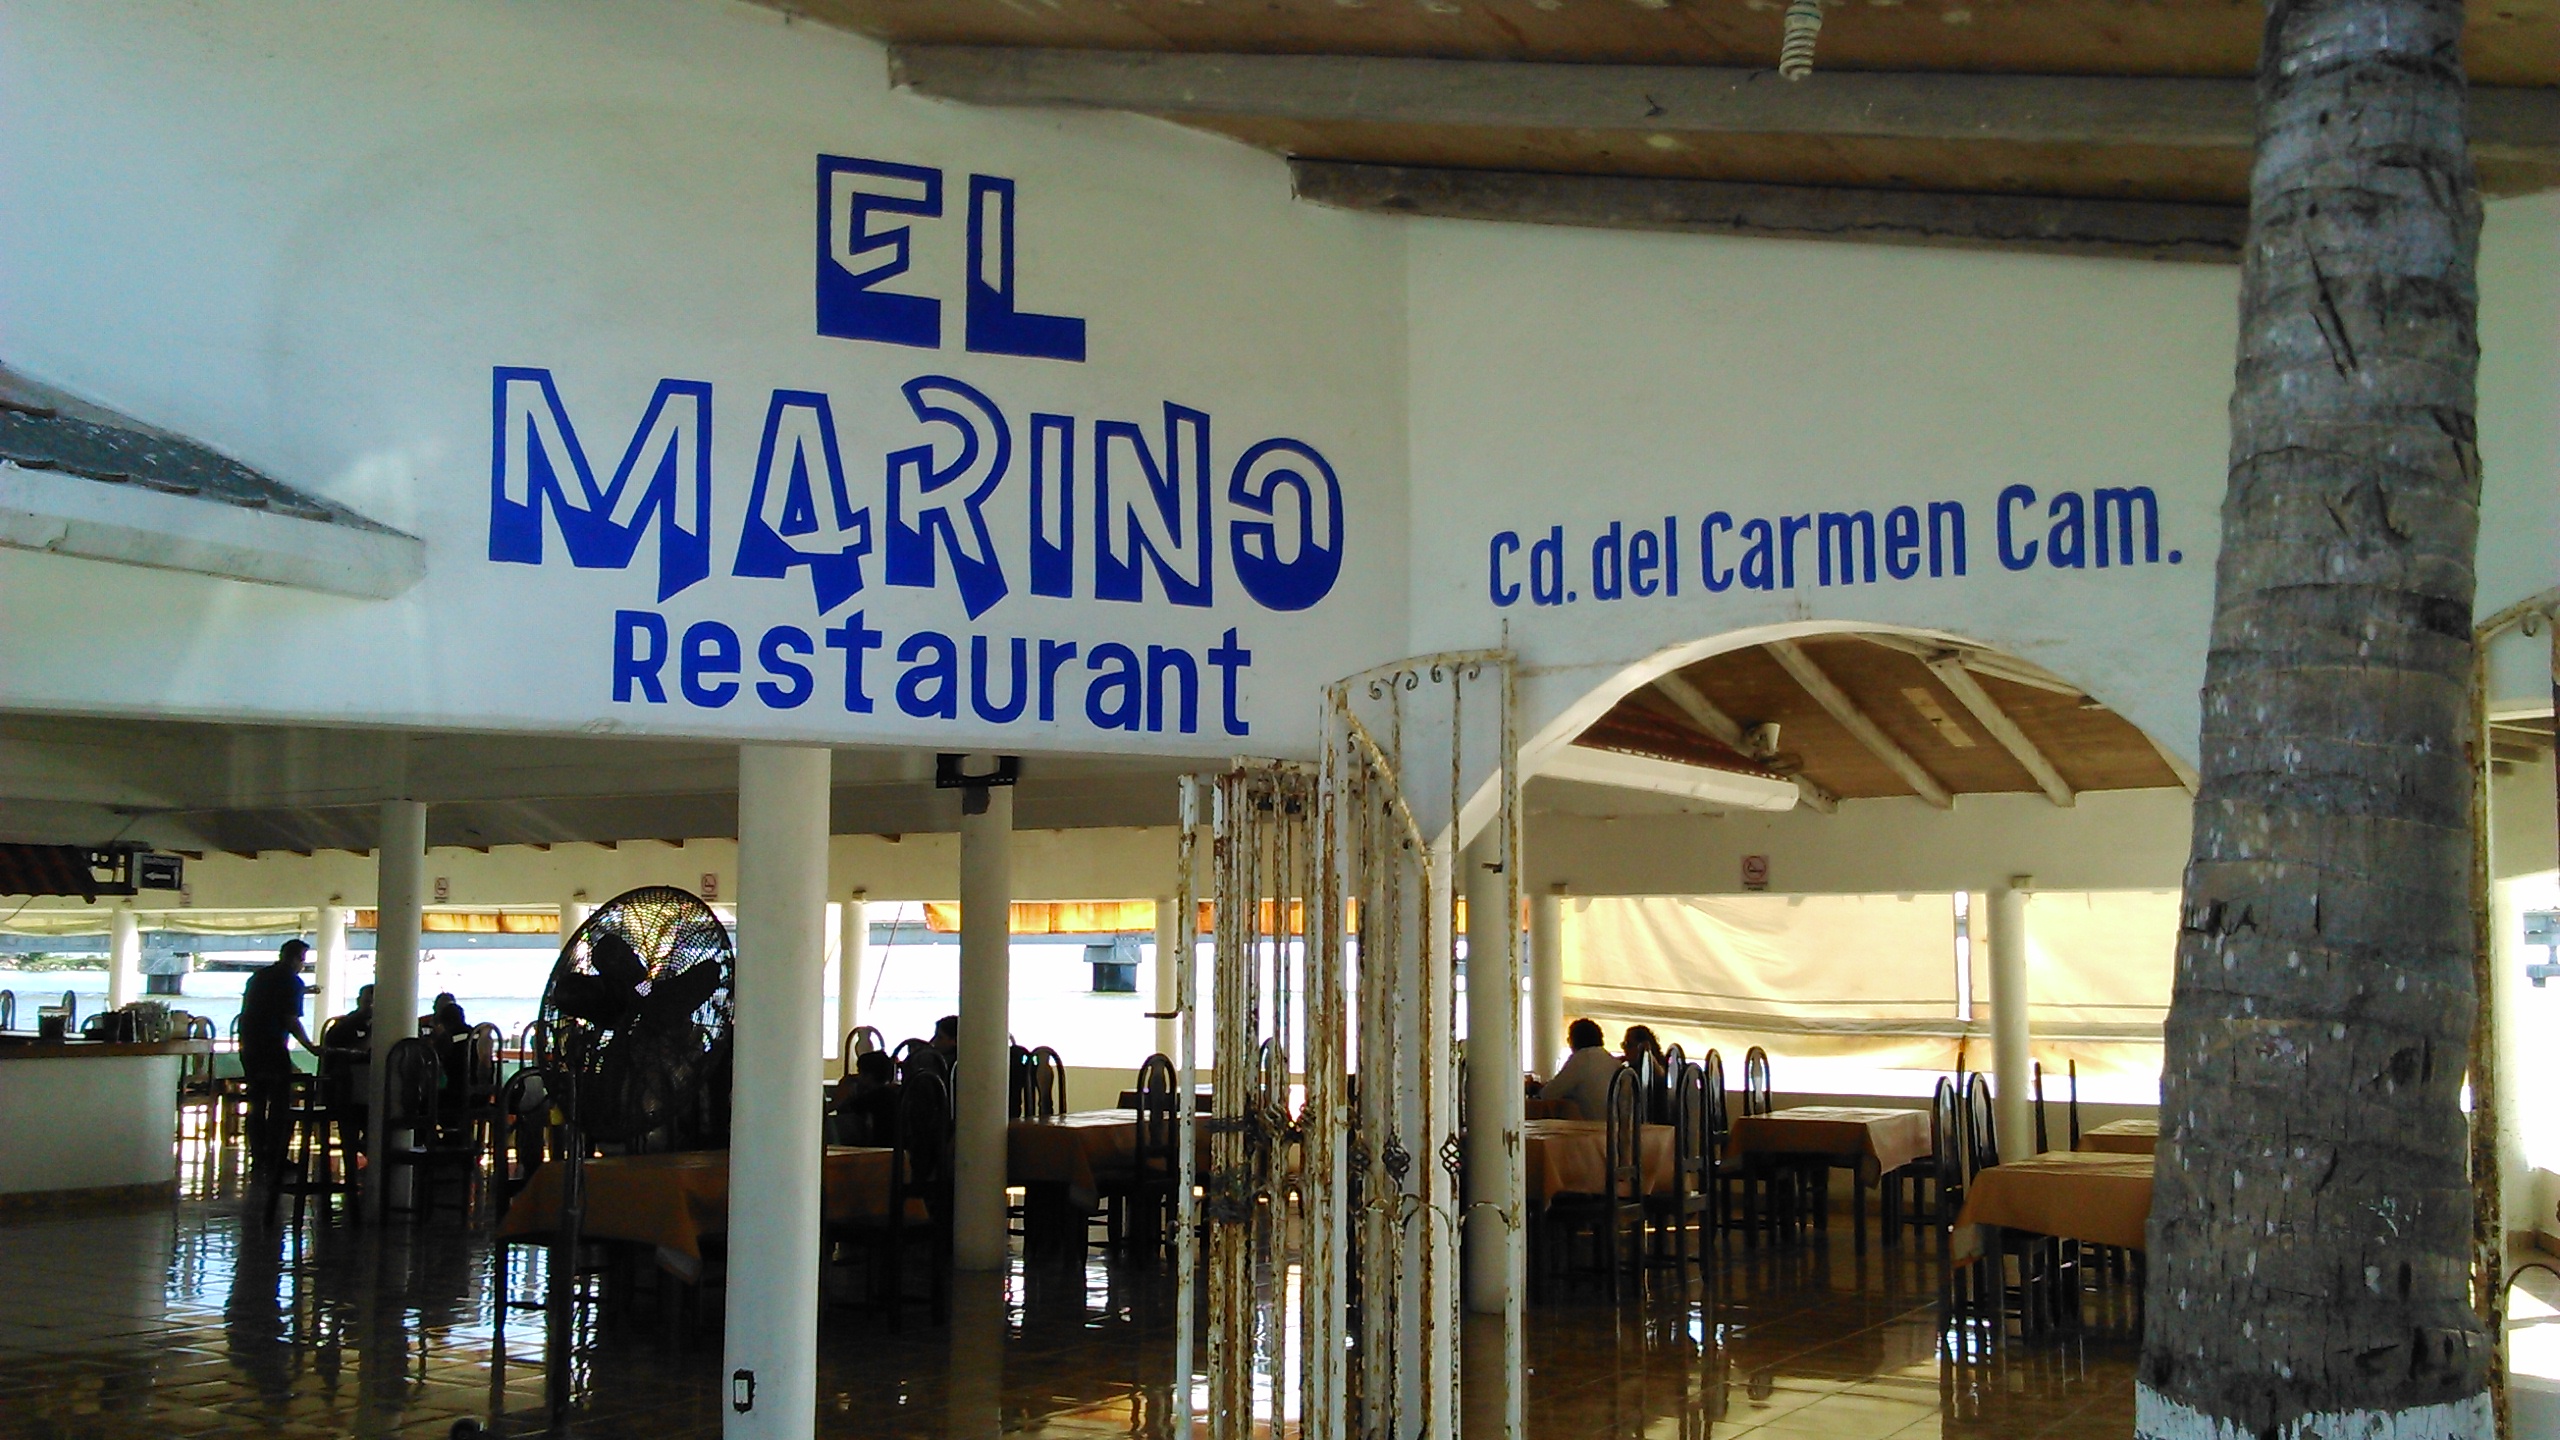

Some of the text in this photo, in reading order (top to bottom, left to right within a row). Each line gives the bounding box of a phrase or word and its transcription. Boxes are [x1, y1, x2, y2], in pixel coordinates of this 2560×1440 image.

[817, 154, 1085, 361] EL
[488, 365, 1344, 621] MARINO
[1489, 484, 2184, 608] Cd. del Carmen Cam.
[611, 609, 1252, 736] Restaurant
